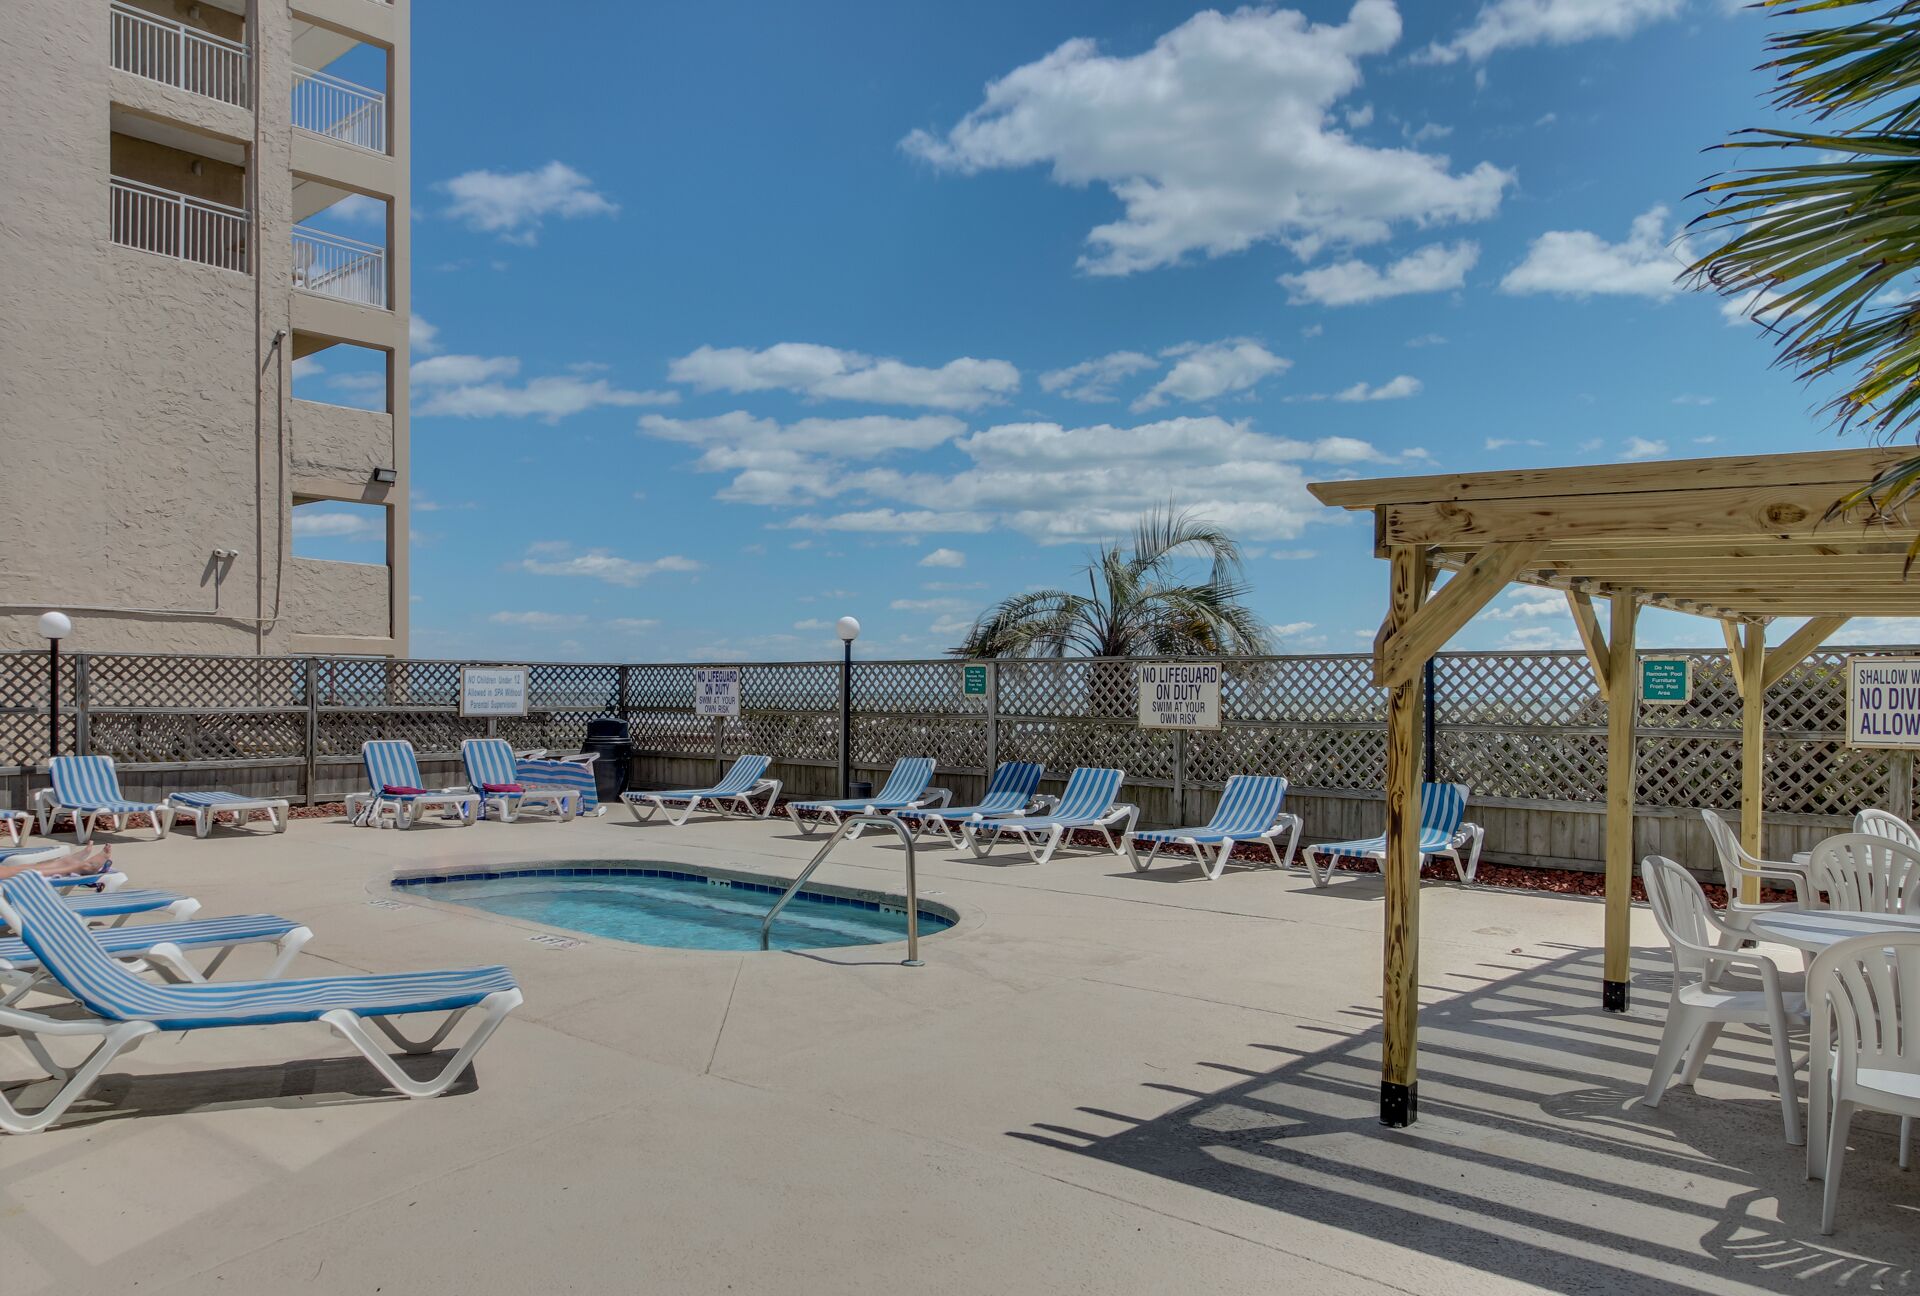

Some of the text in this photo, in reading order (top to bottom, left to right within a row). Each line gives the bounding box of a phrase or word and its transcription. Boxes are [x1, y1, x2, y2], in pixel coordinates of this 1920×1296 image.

[468, 675, 476, 684] NO
[477, 675, 496, 684] Children
[498, 675, 512, 684] Under
[698, 671, 737, 682] NO LIFEGUARD
[1143, 667, 1217, 683] NO LIFEGUARD
[1860, 669, 1908, 684] SHALLOW
[468, 688, 486, 696] Allowed
[494, 688, 504, 696] SPA
[705, 683, 730, 695] ON DUTY
[1156, 684, 1201, 700] ON DUTY
[699, 696, 736, 705] SWIM AT YOUR
[1860, 687, 1882, 710] NO
[471, 700, 517, 710] Parental Supervision
[705, 704, 730, 713] OWN RISK
[1152, 701, 1205, 713] SWIM AT YOUR
[1160, 713, 1197, 725] OWN RISK
